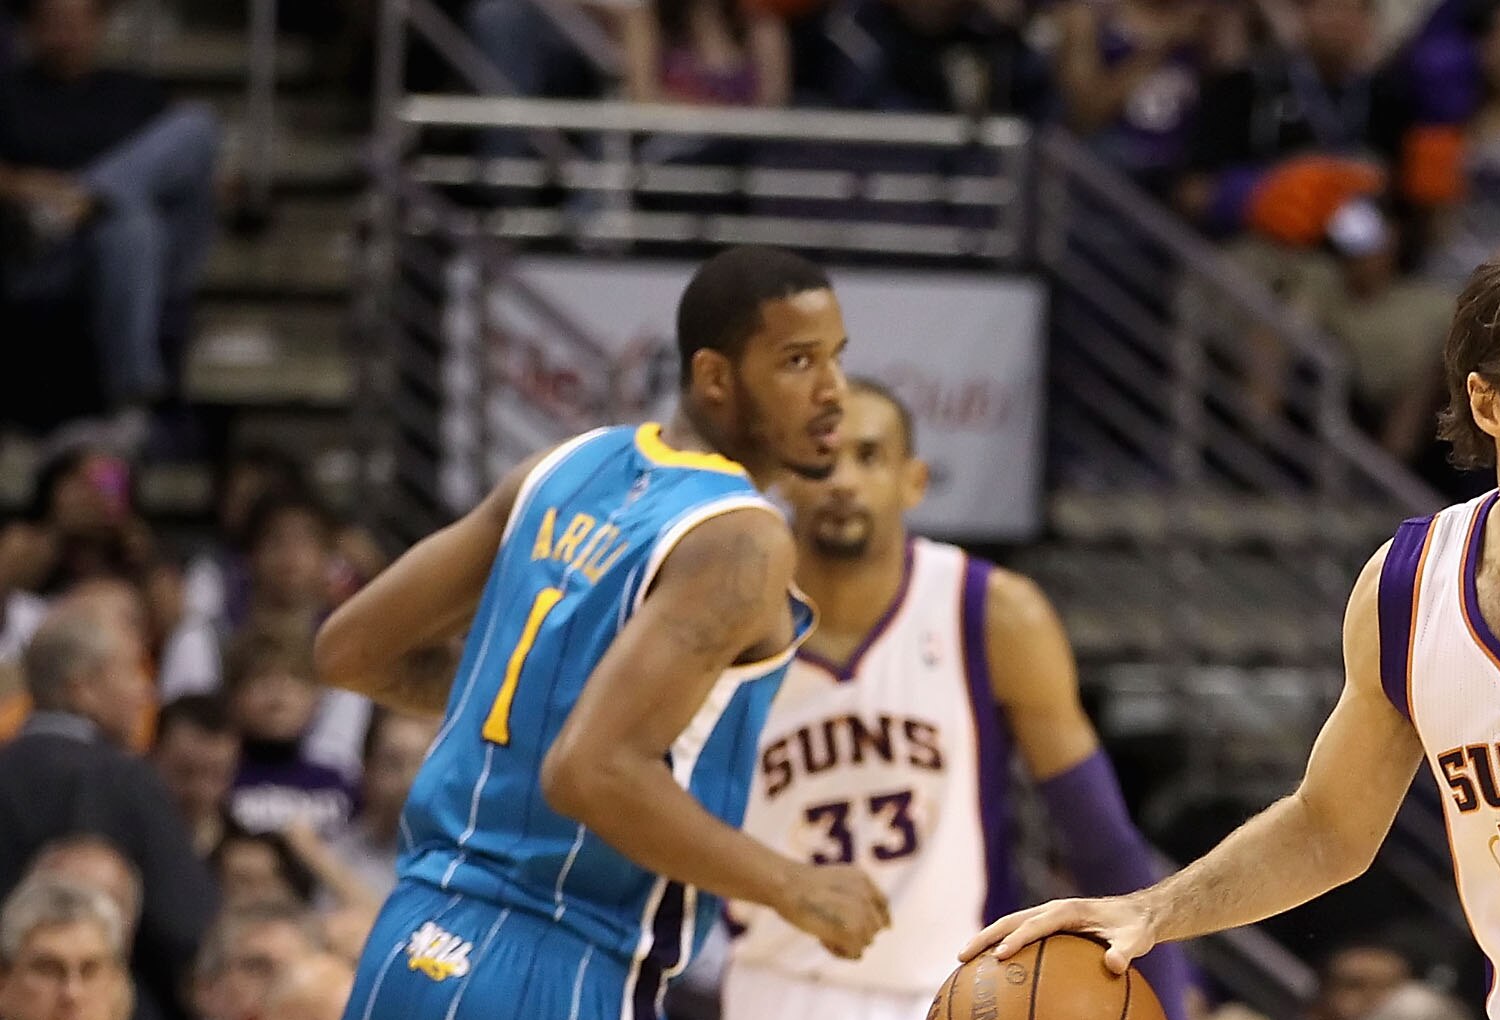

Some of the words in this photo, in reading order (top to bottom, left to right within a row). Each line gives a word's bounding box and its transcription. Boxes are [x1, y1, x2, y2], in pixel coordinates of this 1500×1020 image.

[481, 586, 565, 745] 1
[762, 715, 944, 798] SUNS
[806, 789, 919, 867] 33
